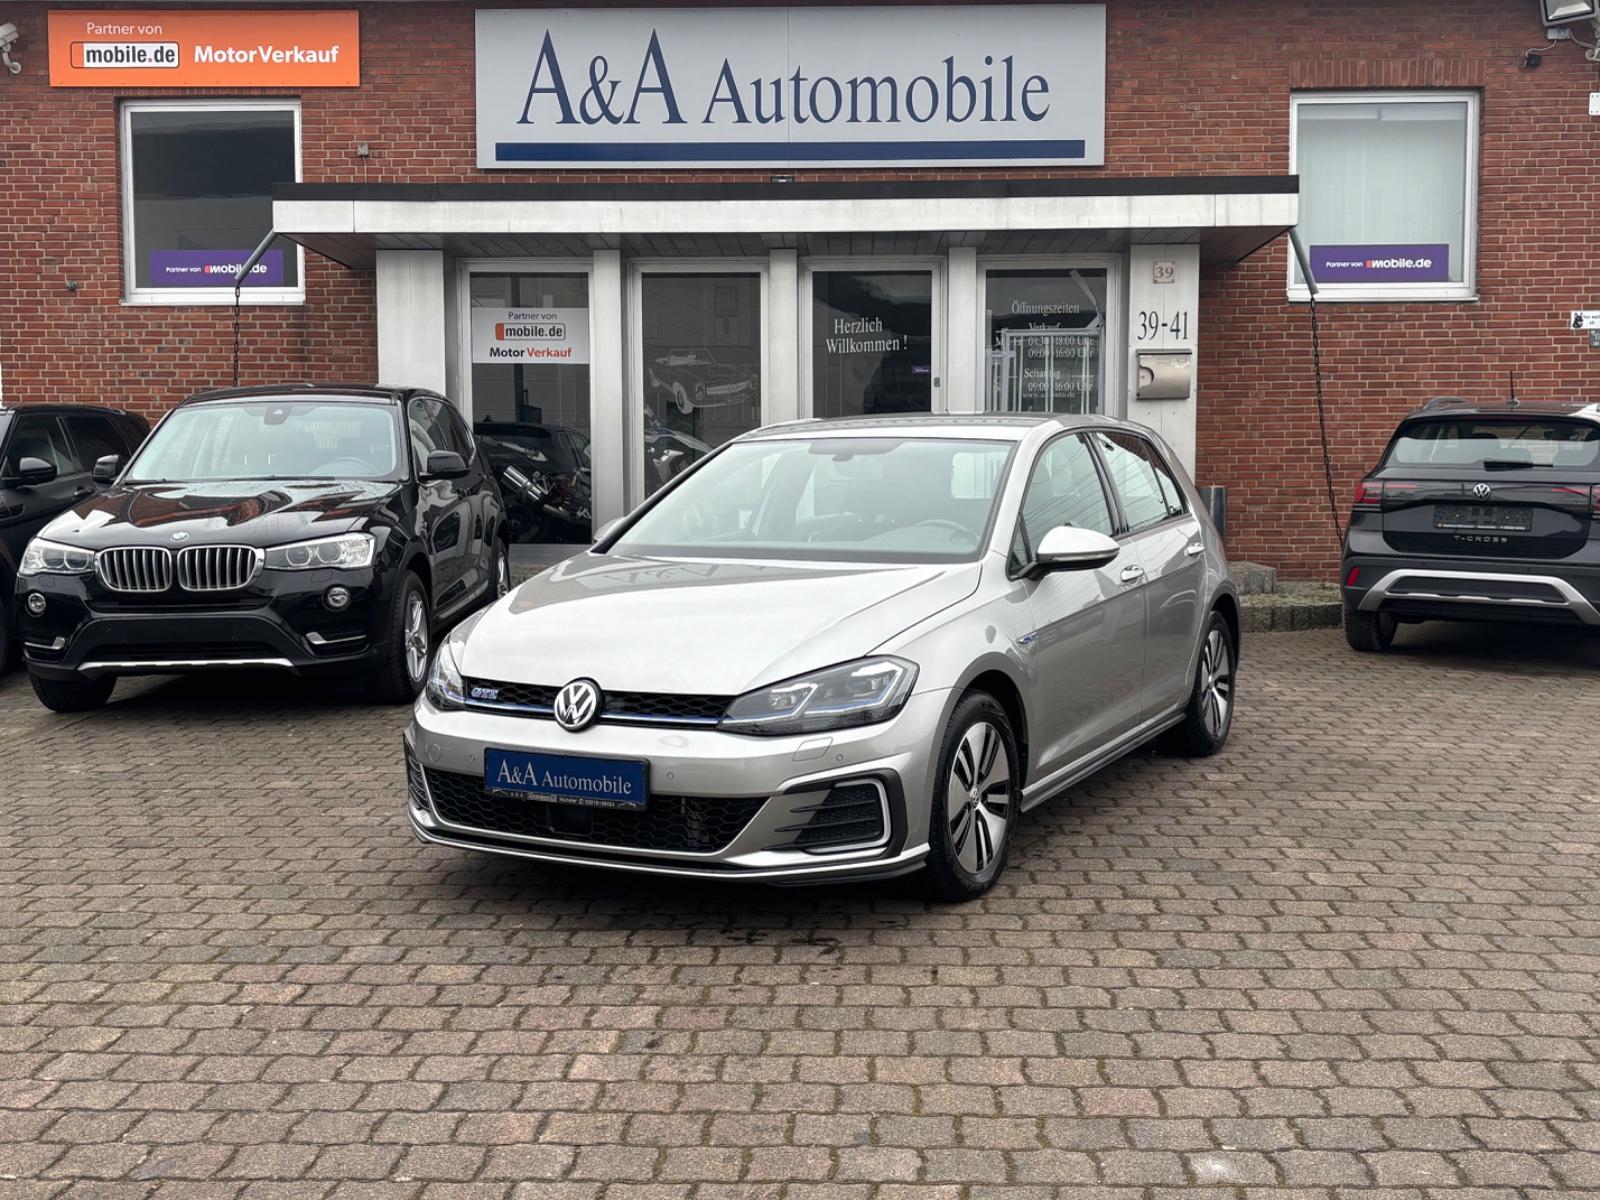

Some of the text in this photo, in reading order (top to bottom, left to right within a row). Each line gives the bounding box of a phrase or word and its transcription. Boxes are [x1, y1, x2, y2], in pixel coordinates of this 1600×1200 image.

[86, 22, 163, 35] Partner von
[85, 46, 176, 63] mobile.de
[515, 28, 1051, 124] A&A Automobile
[210, 263, 268, 274] mobil.de
[1372, 258, 1432, 269] mobile.de
[1155, 266, 1174, 279] 39
[1011, 300, 1080, 317] Öffnungszeiten
[508, 311, 539, 320] Partner
[505, 325, 563, 337] mobile.de
[834, 316, 883, 334] Herzlich
[1137, 310, 1188, 341] 39-41
[826, 338, 900, 354] Willkommen
[1077, 336, 1093, 346] Ur
[1077, 348, 1093, 358] Ur
[497, 758, 632, 794] A&A Automobile
